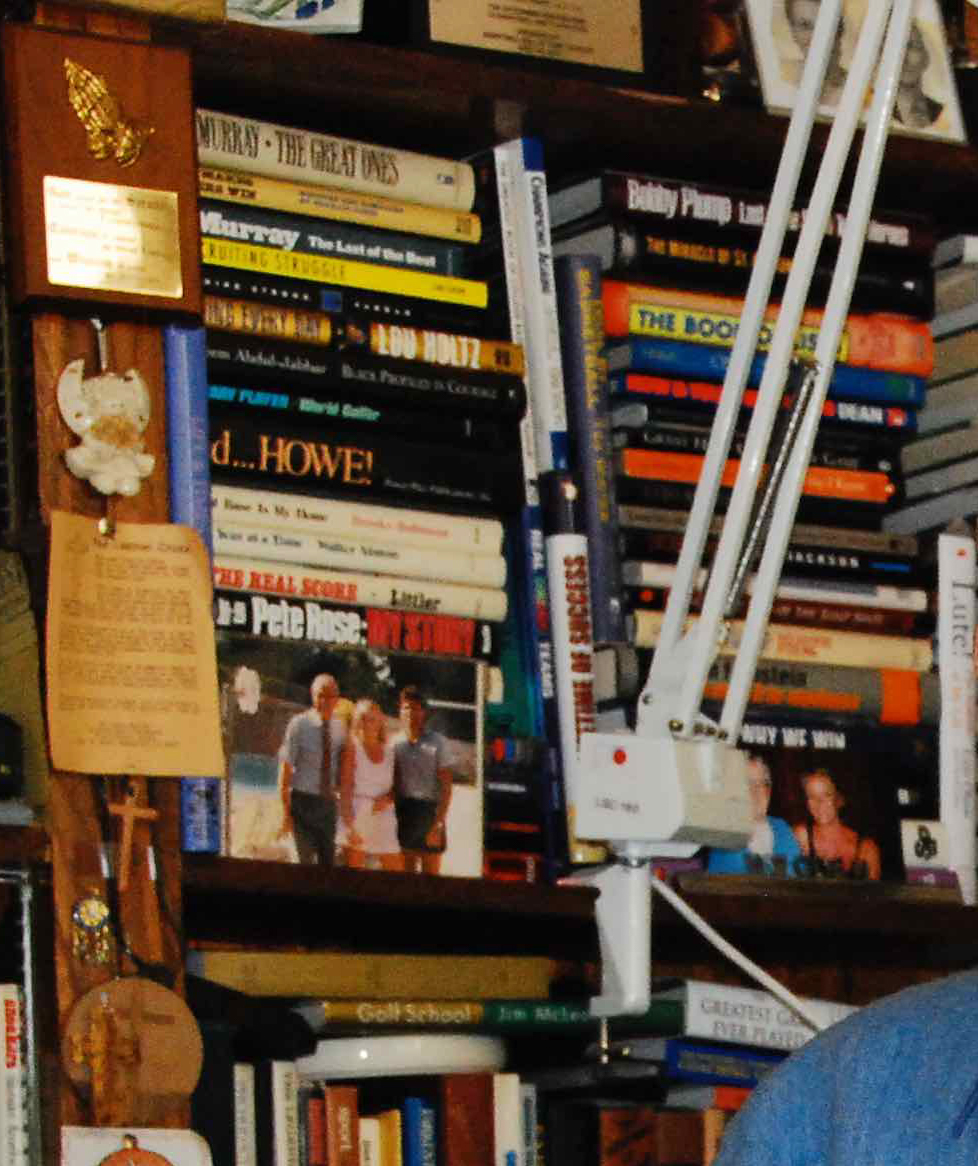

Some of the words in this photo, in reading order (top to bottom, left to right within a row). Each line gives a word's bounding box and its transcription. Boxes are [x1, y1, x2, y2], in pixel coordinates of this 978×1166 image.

[275, 131, 309, 168] THE
[310, 138, 358, 182] GREAT
[361, 146, 400, 186] ONES
[199, 208, 300, 251] Murray
[307, 234, 336, 252] The
[336, 239, 365, 255] Last
[367, 244, 382, 258] of
[383, 247, 405, 262] the
[406, 250, 437, 268] Best
[638, 308, 676, 333] THE
[377, 324, 418, 359] LOU
[422, 328, 482, 369] HOLTZ
[249, 570, 298, 596] REAL
[251, 595, 305, 639] Pete
[741, 725, 778, 747] WHY
[780, 727, 807, 749] WE
[812, 728, 847, 752] WIN
[357, 1004, 402, 1024] Golf
[404, 1004, 472, 1024] School
